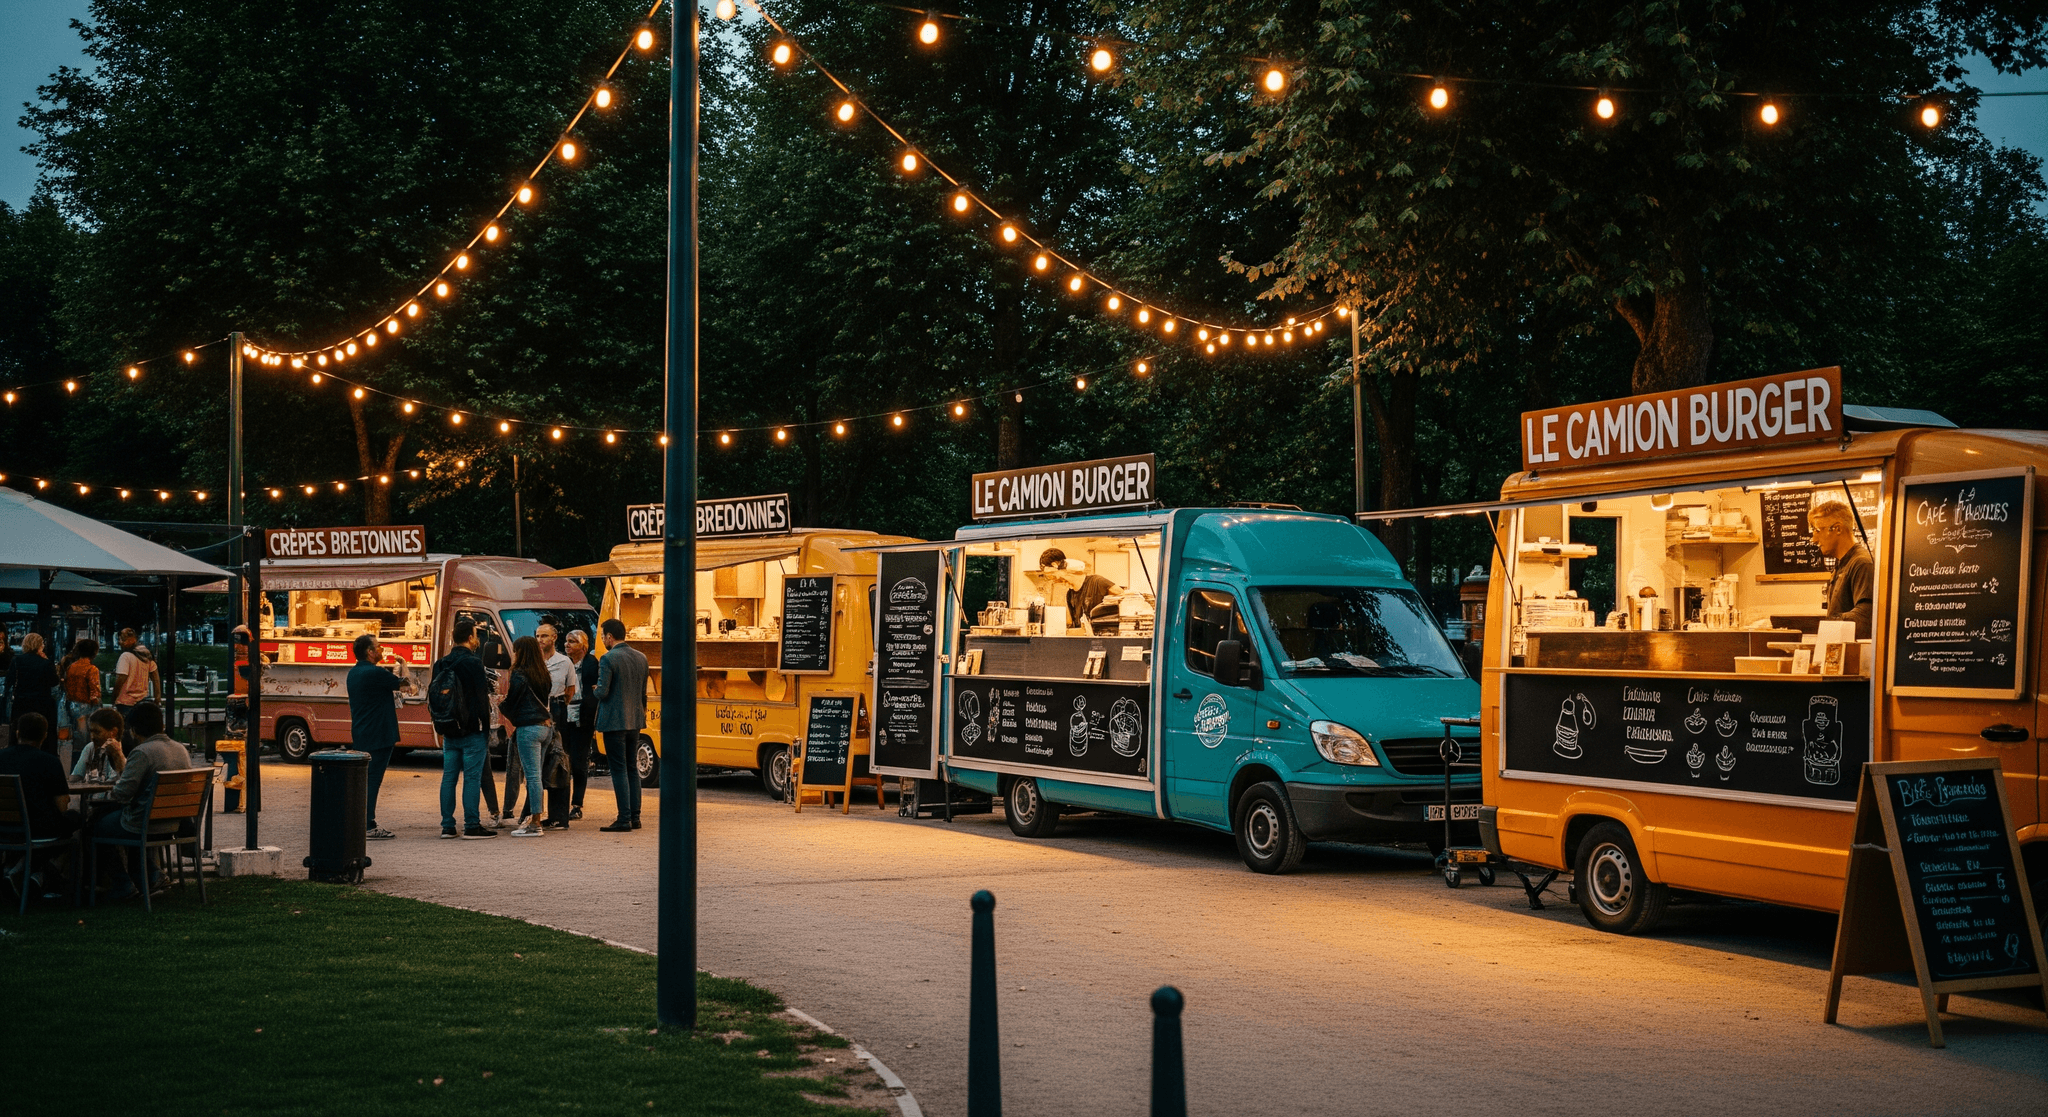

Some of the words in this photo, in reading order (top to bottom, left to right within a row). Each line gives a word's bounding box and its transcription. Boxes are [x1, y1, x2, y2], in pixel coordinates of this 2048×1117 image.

[1526, 414, 1560, 464] LE
[1566, 397, 1679, 459] CAMION
[1690, 377, 1832, 446] BURGER
[975, 479, 995, 514] LE
[998, 470, 1066, 511] CAMION
[1071, 461, 1149, 505] BURGER
[696, 499, 786, 533] BREDONNES
[330, 529, 422, 555] BRETONNES
